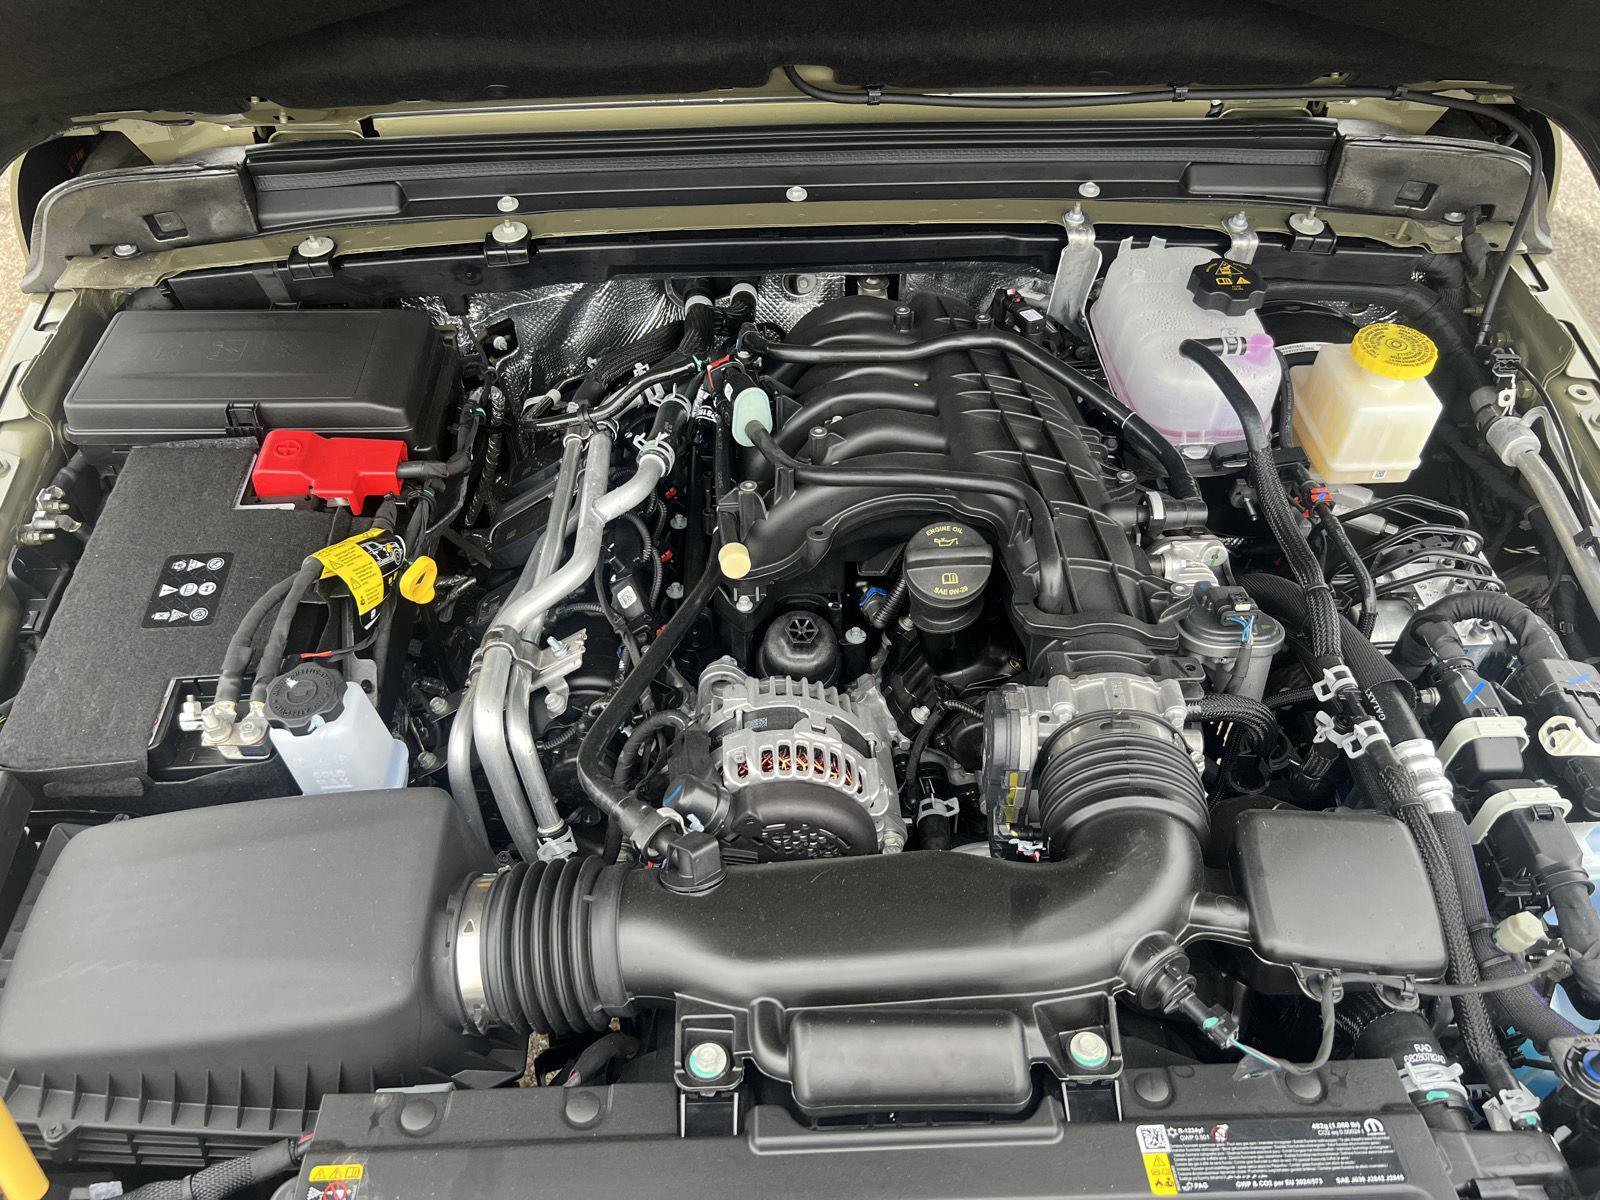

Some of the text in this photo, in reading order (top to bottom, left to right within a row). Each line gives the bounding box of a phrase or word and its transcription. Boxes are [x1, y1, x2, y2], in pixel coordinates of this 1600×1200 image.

[926, 525, 963, 536] ENGINE OIL
[934, 587, 948, 595] SAE
[1414, 1044, 1432, 1052] RAD
